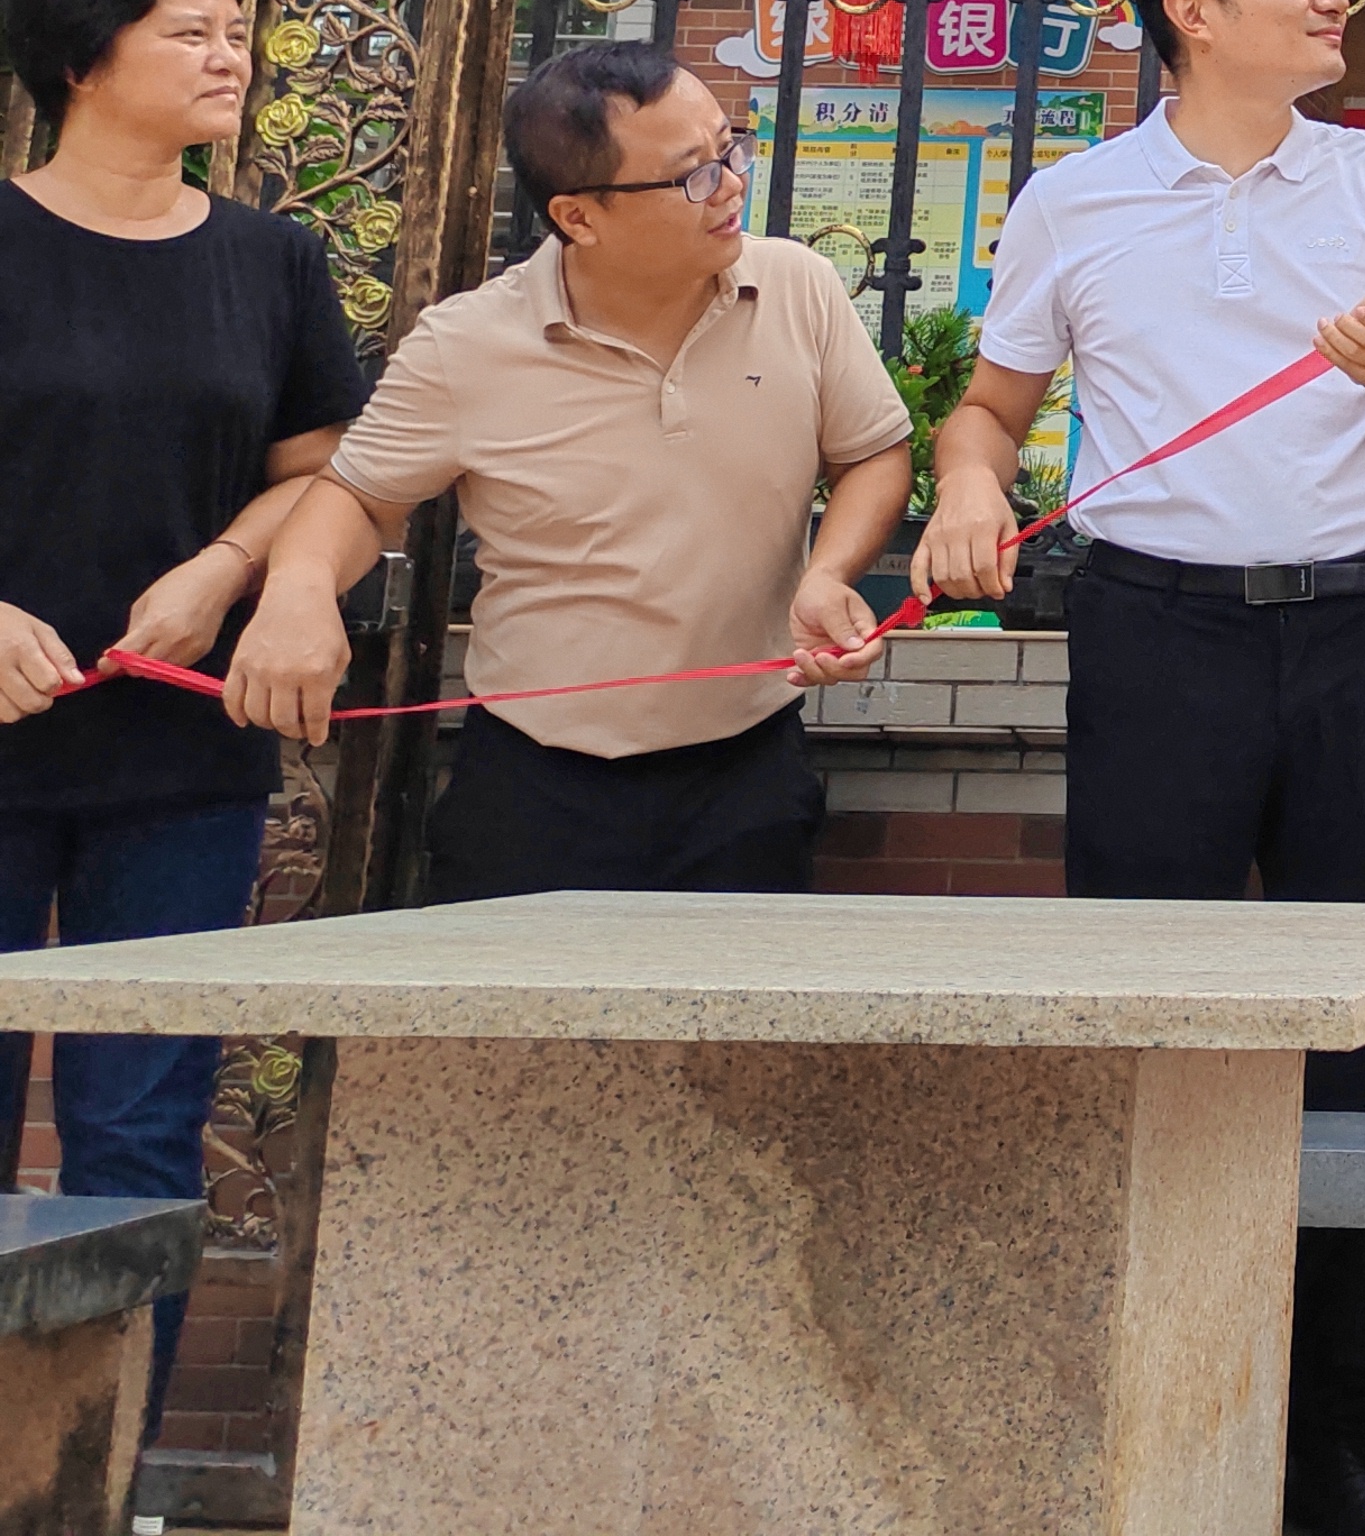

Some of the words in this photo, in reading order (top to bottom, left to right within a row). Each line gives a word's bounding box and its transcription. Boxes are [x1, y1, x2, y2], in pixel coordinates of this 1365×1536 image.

[815, 101, 889, 123] 积分清
[1003, 109, 1076, 125] 开流程
